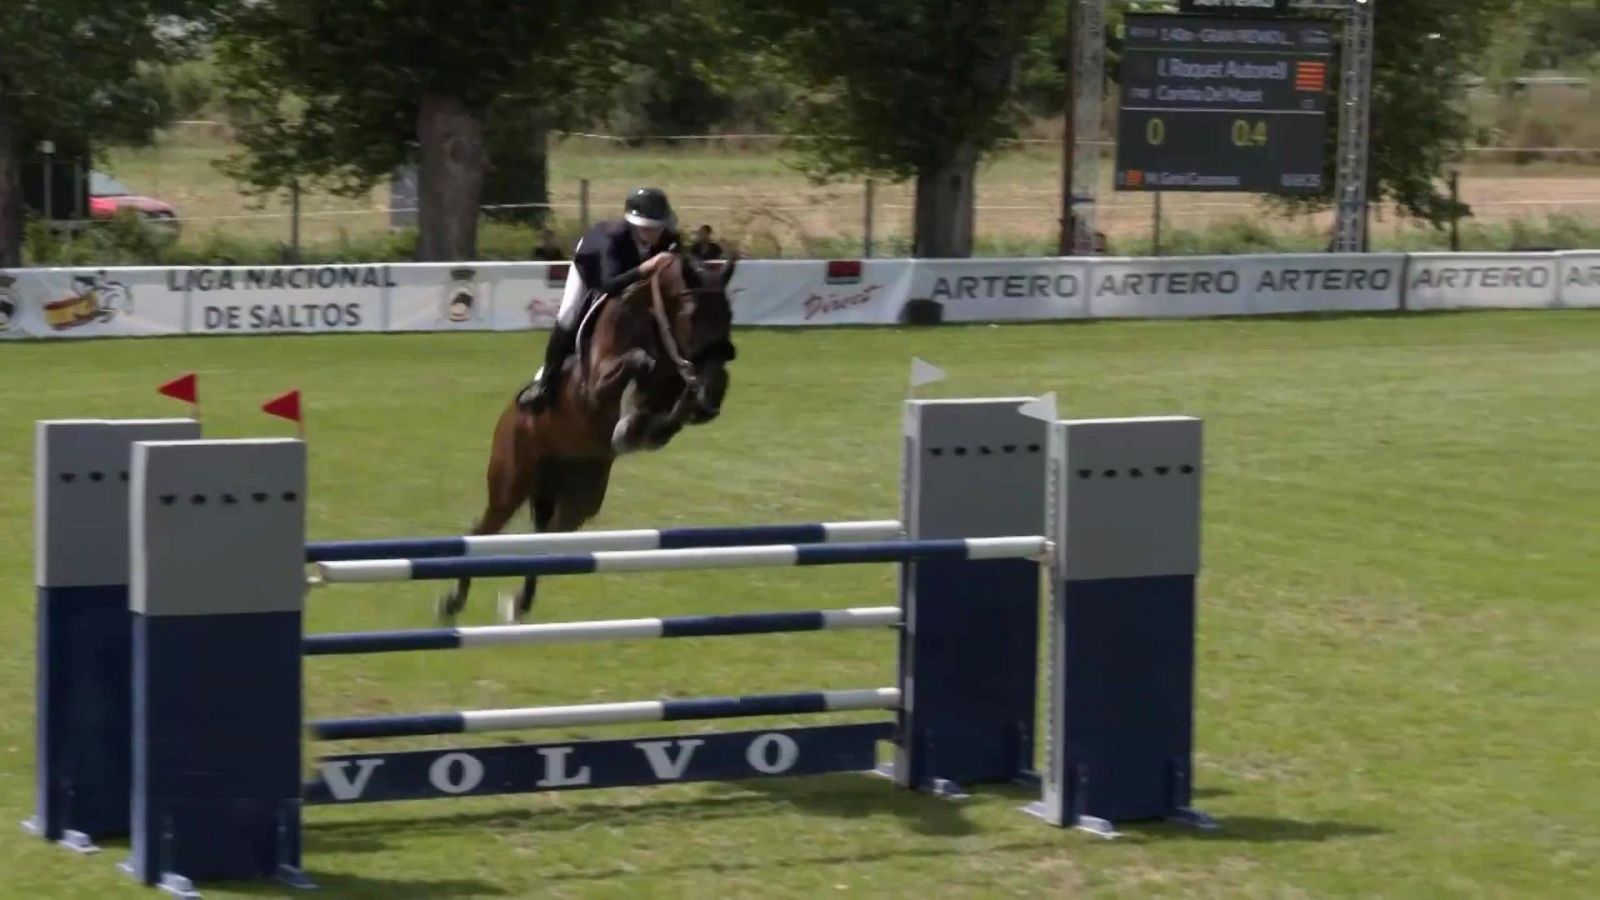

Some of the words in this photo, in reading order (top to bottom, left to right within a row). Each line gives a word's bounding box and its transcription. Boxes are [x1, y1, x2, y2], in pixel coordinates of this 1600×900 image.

[1146, 118, 1165, 146] 0
[167, 269, 237, 292] LIGA
[244, 265, 397, 290] NACIONAL
[930, 274, 1079, 300] ARTERO
[1096, 270, 1240, 297] ARTERO
[1255, 268, 1392, 292] ARTERO
[1411, 266, 1549, 289] ARTERO
[204, 306, 241, 329] DE
[250, 302, 362, 328] SALTOS
[319, 732, 800, 801] VOLVO
